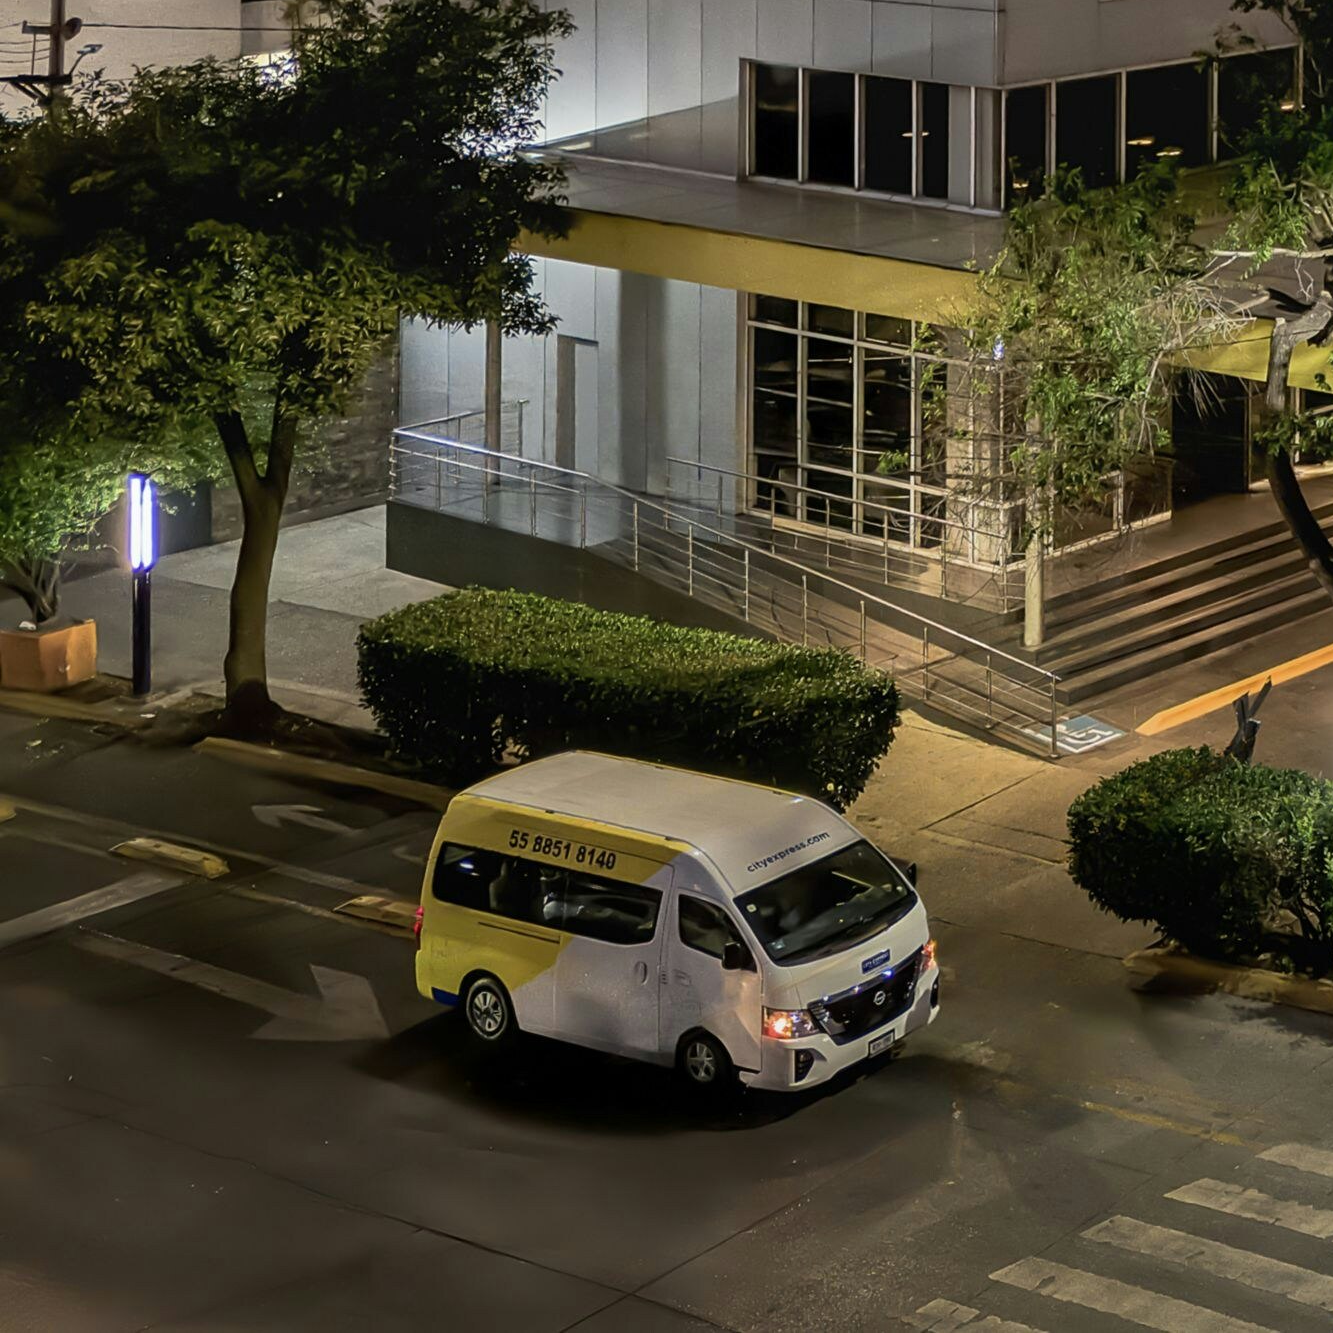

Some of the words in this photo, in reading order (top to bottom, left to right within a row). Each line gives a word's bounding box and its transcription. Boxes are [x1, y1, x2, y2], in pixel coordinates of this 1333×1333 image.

[509, 829, 530, 849] 55
[532, 835, 572, 860] 8851
[576, 845, 617, 870] 8140
[747, 831, 831, 873] cityexpress.com
